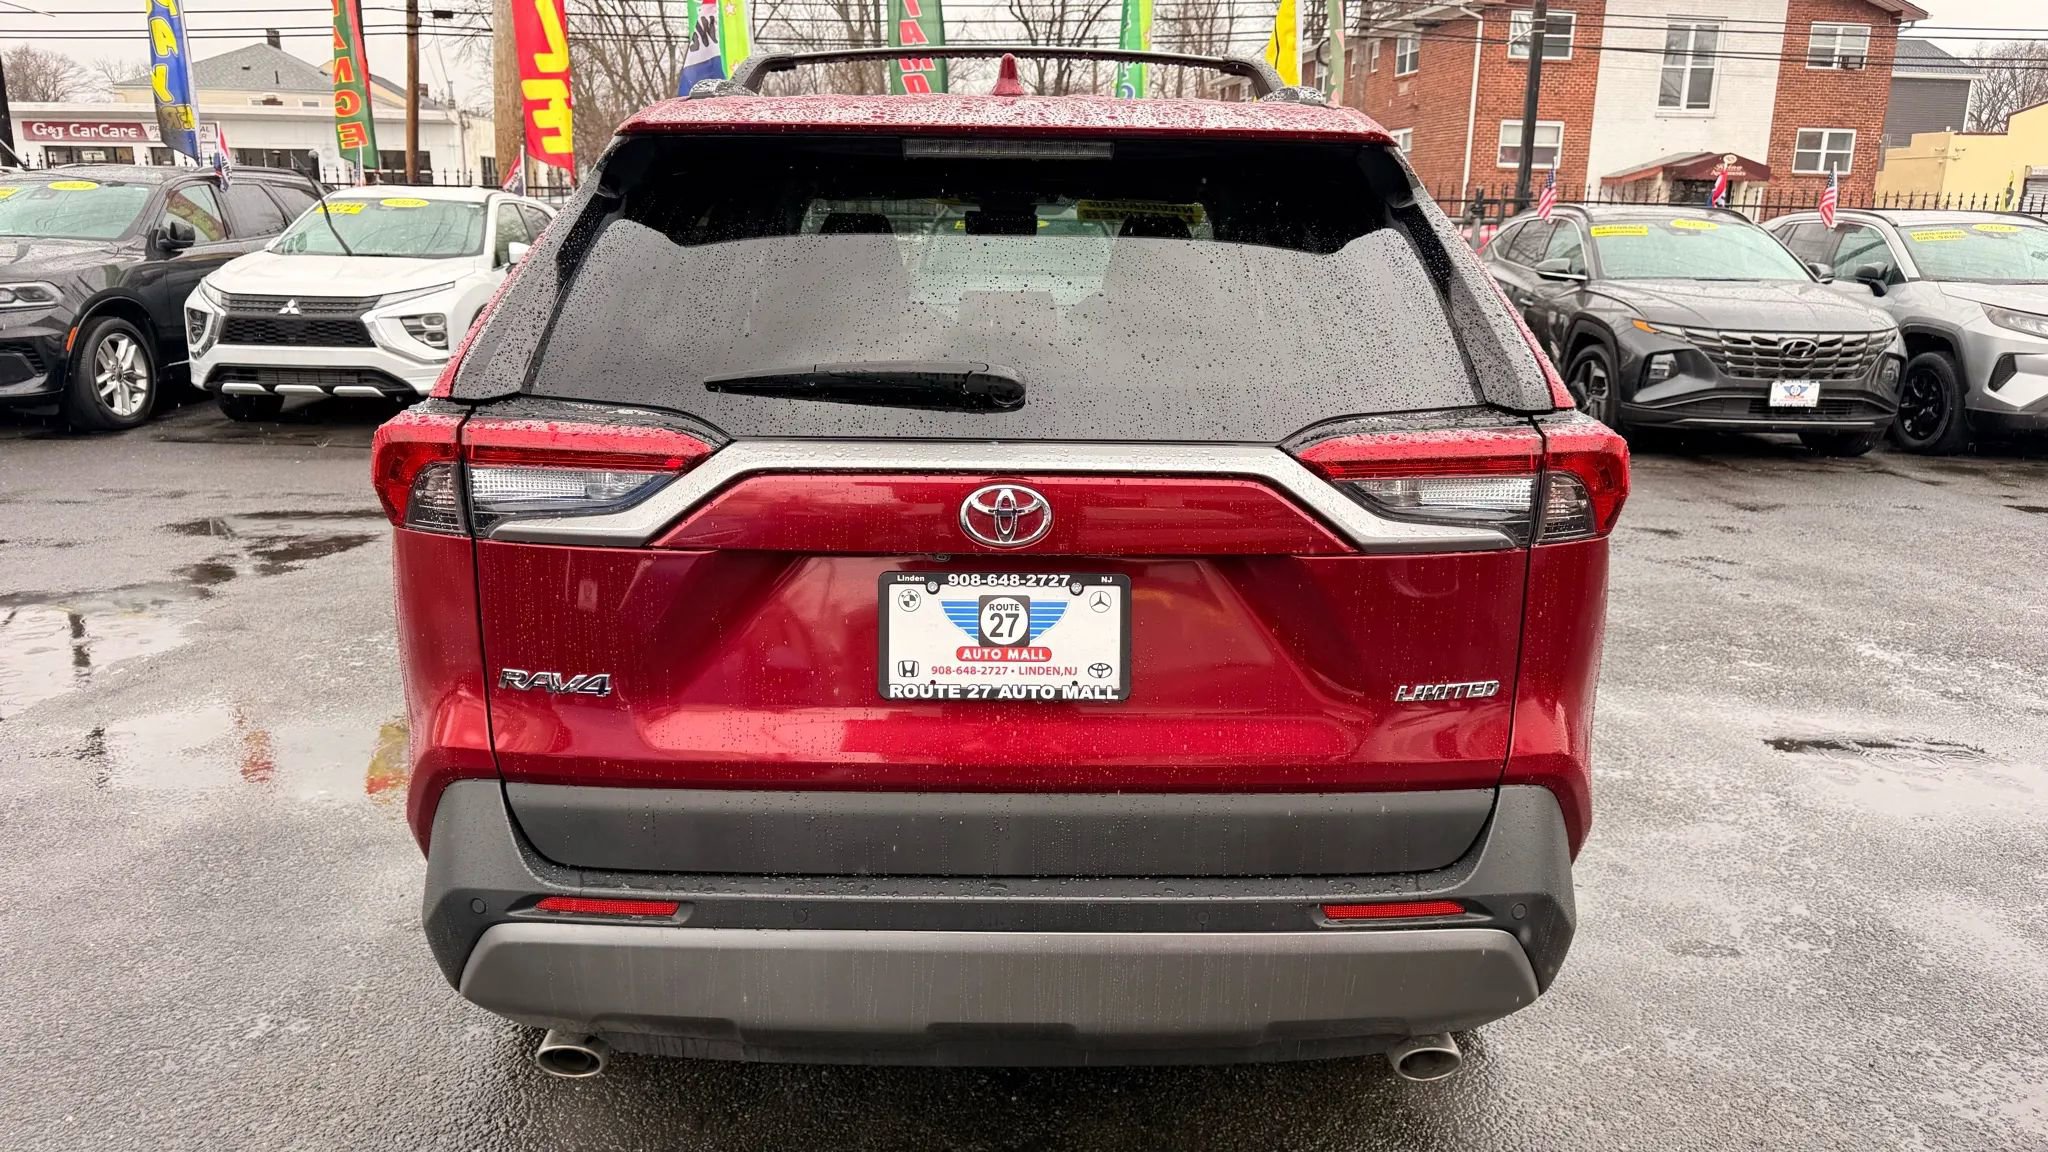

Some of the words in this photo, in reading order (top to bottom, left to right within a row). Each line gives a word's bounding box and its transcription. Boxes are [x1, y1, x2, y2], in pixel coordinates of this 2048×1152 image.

[32, 123, 65, 139] G&J
[69, 124, 138, 138] CarCare
[948, 574, 1071, 587] 908-648-2727
[989, 603, 1020, 611] ROUTE
[989, 613, 1020, 638] 27
[962, 648, 1002, 661] AUTO
[1010, 648, 1046, 660] MALL
[931, 666, 1008, 675] 908-648-2727
[498, 668, 612, 697] RAV4
[889, 684, 961, 699] ROUTE
[967, 684, 992, 699] 27
[998, 685, 1057, 700] AUTO
[1062, 685, 1119, 700] MALL
[1395, 680, 1499, 702] LIMITED
